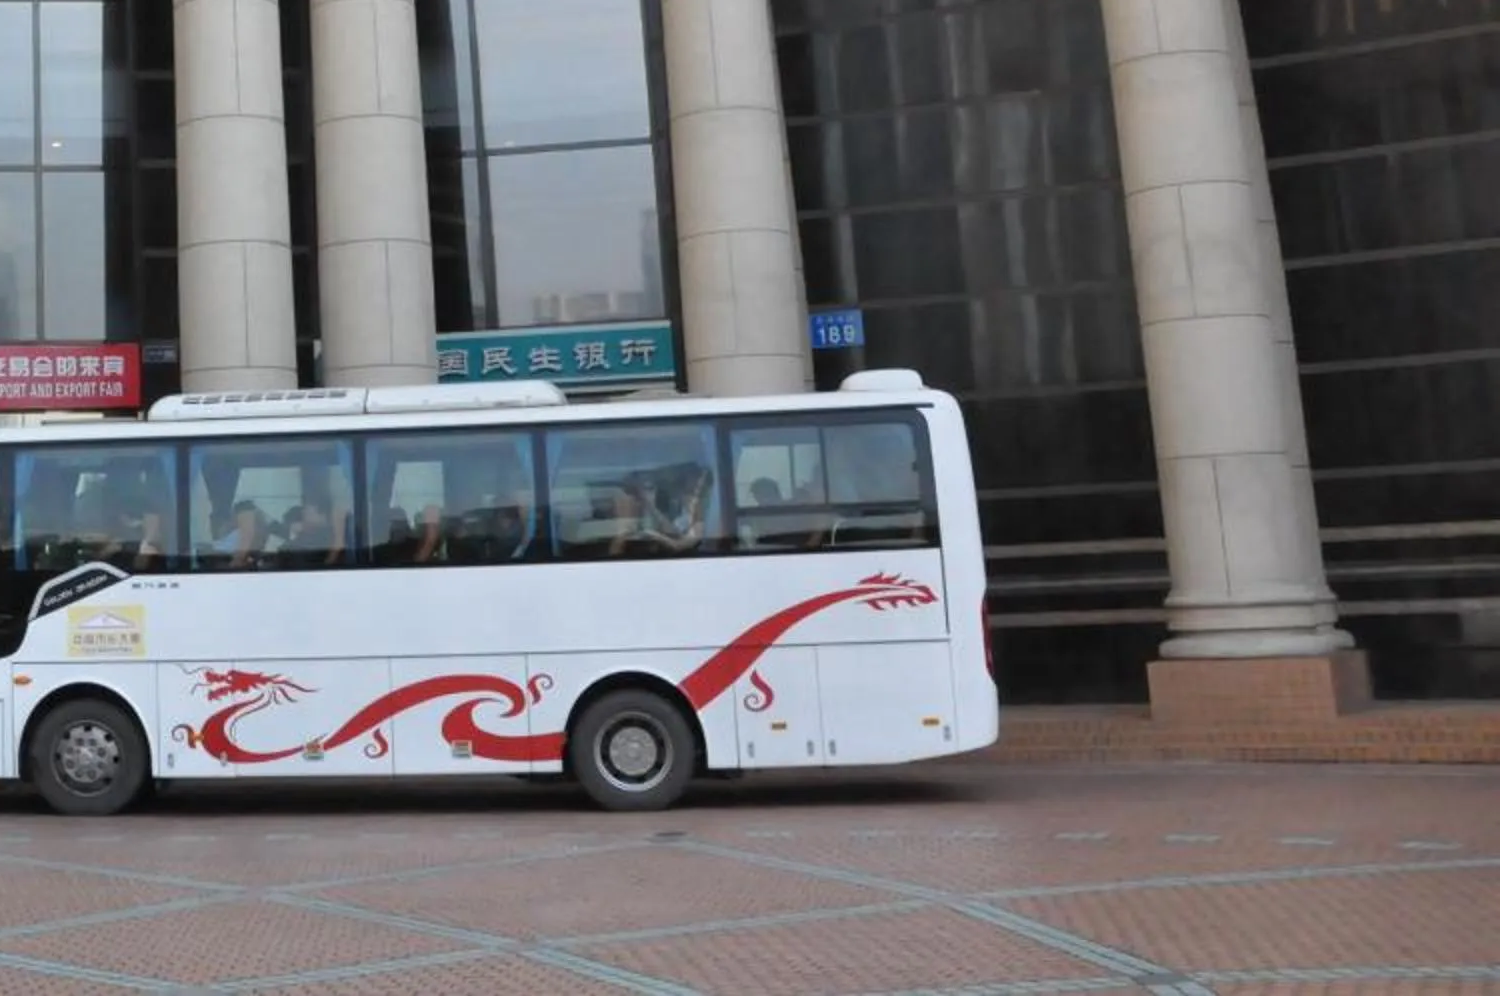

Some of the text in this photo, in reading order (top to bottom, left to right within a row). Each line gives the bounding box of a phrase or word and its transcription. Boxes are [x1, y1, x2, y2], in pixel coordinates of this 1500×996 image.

[30, 382, 52, 397] AND
[55, 382, 97, 397] EXPORT
[100, 381, 123, 396] FAIR
